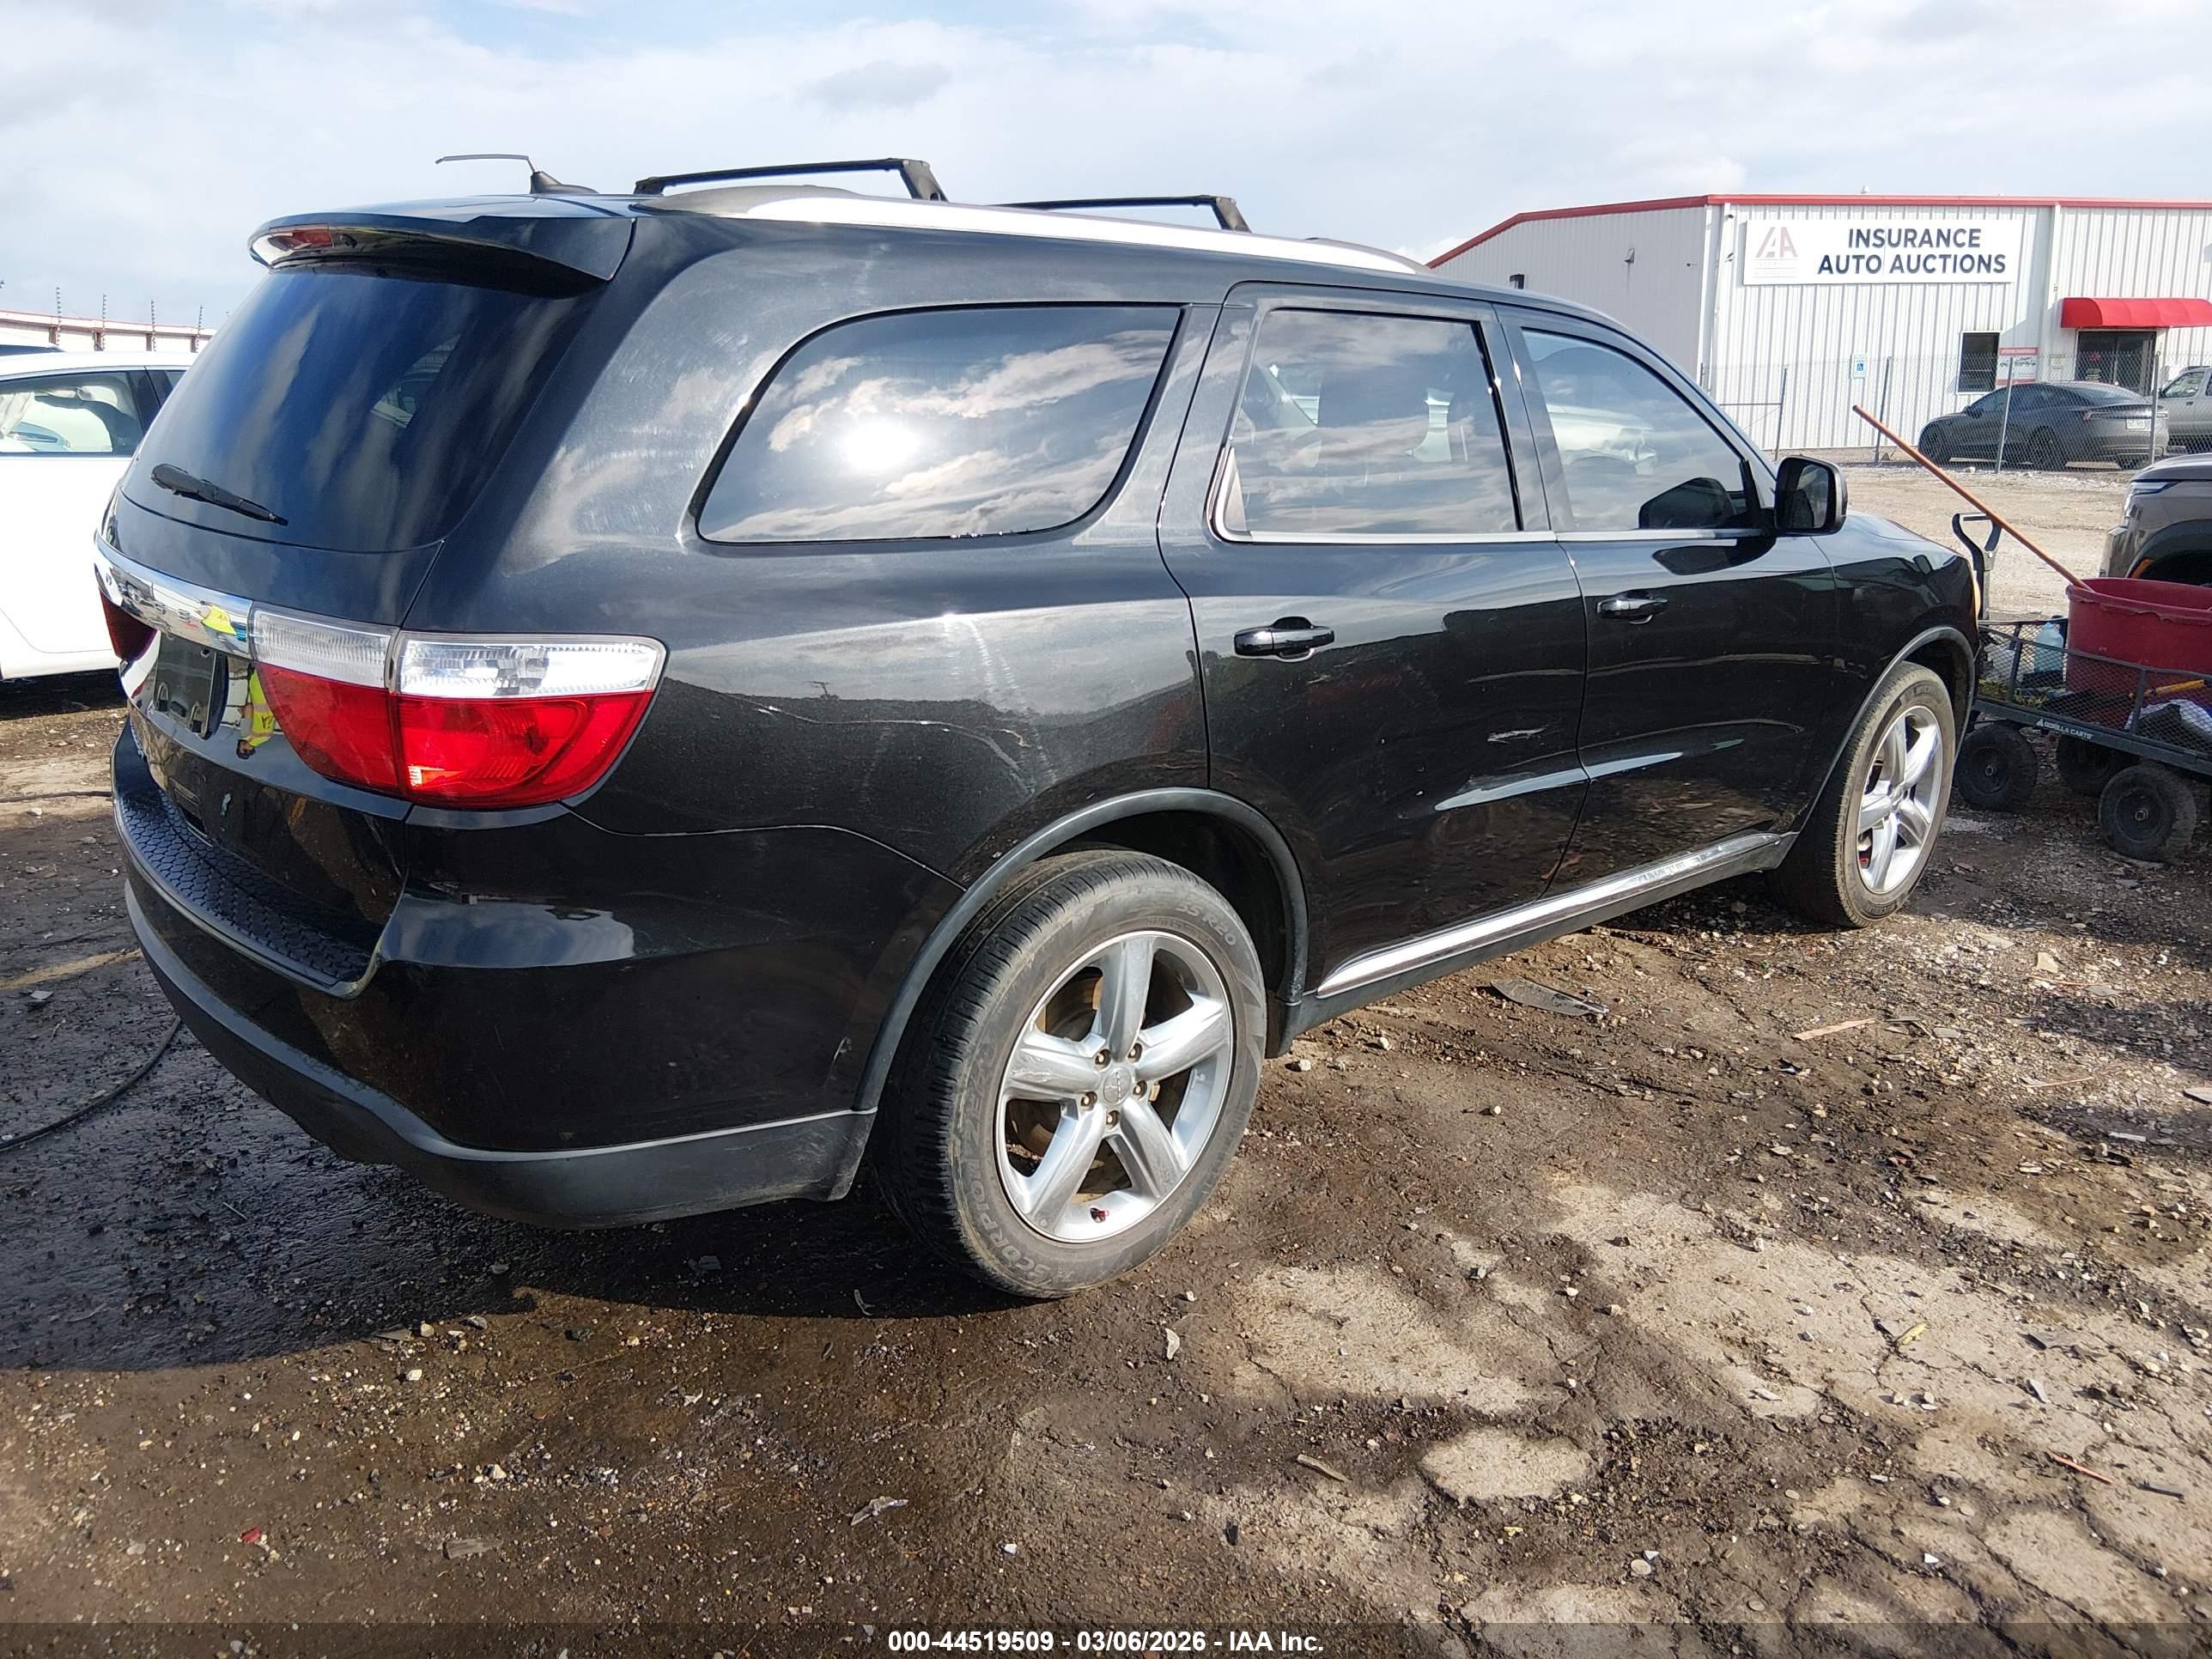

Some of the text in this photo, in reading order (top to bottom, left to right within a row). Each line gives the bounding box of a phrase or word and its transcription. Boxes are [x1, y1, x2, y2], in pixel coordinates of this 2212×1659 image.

[1848, 228, 1982, 249] INSURANCE
[1817, 253, 2007, 275] AUTO AUCTIONS
